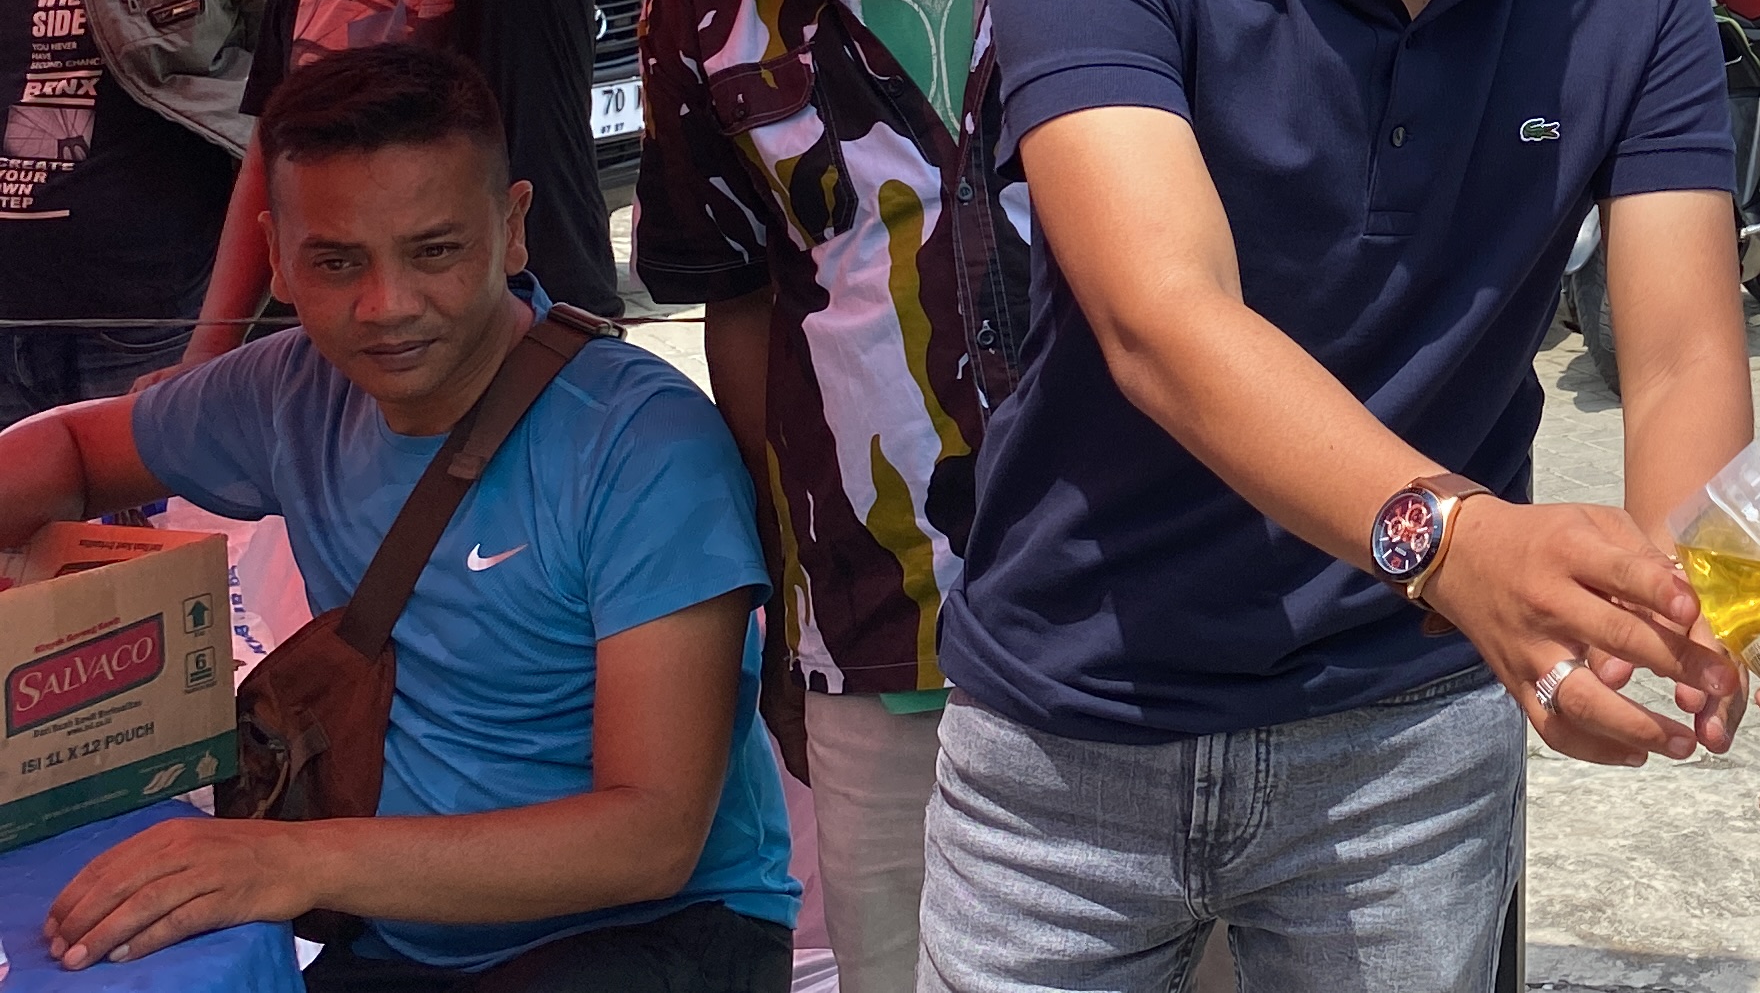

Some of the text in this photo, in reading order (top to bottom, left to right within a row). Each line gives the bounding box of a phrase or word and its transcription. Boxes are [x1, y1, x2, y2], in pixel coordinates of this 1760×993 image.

[32, 9, 87, 37] SIDE
[16, 636, 153, 712] SALVACO
[195, 653, 206, 669] 6
[21, 721, 155, 775] ISI 1L X 12 POUCH
